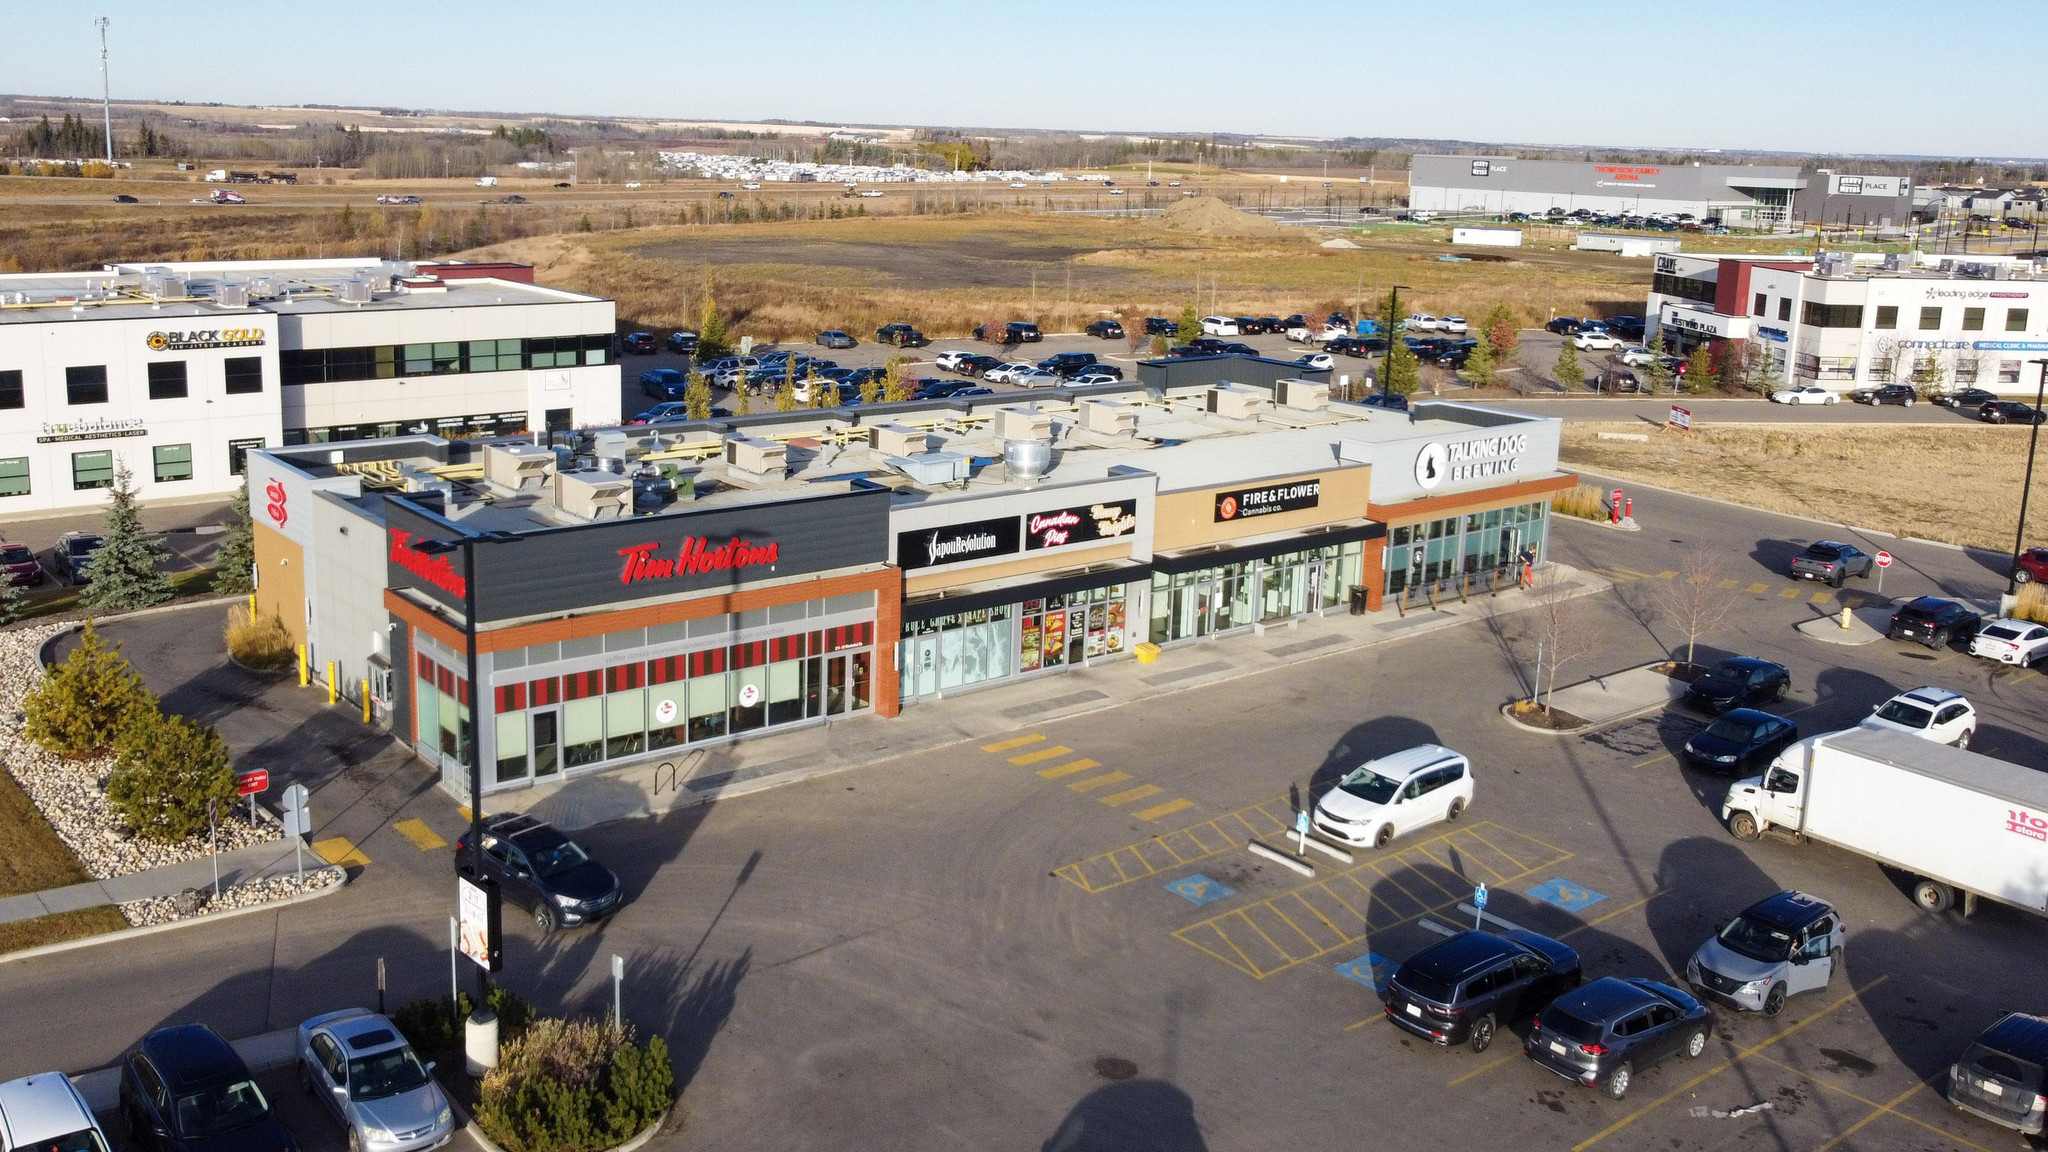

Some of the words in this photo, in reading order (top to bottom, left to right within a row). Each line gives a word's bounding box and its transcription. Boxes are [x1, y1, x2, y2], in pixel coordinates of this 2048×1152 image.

[1657, 256, 1677, 270] CRAVE
[1938, 289, 1966, 299] leading
[1968, 289, 1989, 299] edge
[168, 330, 220, 343] BLACK
[222, 327, 264, 341] GOLD
[1700, 324, 1717, 334] PLAZA
[1898, 338, 1970, 350] connectcare
[55, 433, 83, 442] MEDICAL
[84, 429, 121, 439] AESTHETICS
[124, 427, 145, 436] LASER
[1448, 438, 1498, 462] TALKING
[1499, 434, 1528, 455] DOG
[1452, 457, 1519, 481] BREWING
[1242, 504, 1272, 517] Cannabis
[1030, 510, 1080, 534] Canadian
[1043, 528, 1069, 547] Pies
[618, 541, 675, 585] Tim
[676, 535, 779, 576] Hortons
[1875, 555, 1892, 563] STOP
[2014, 825, 2045, 840] store
